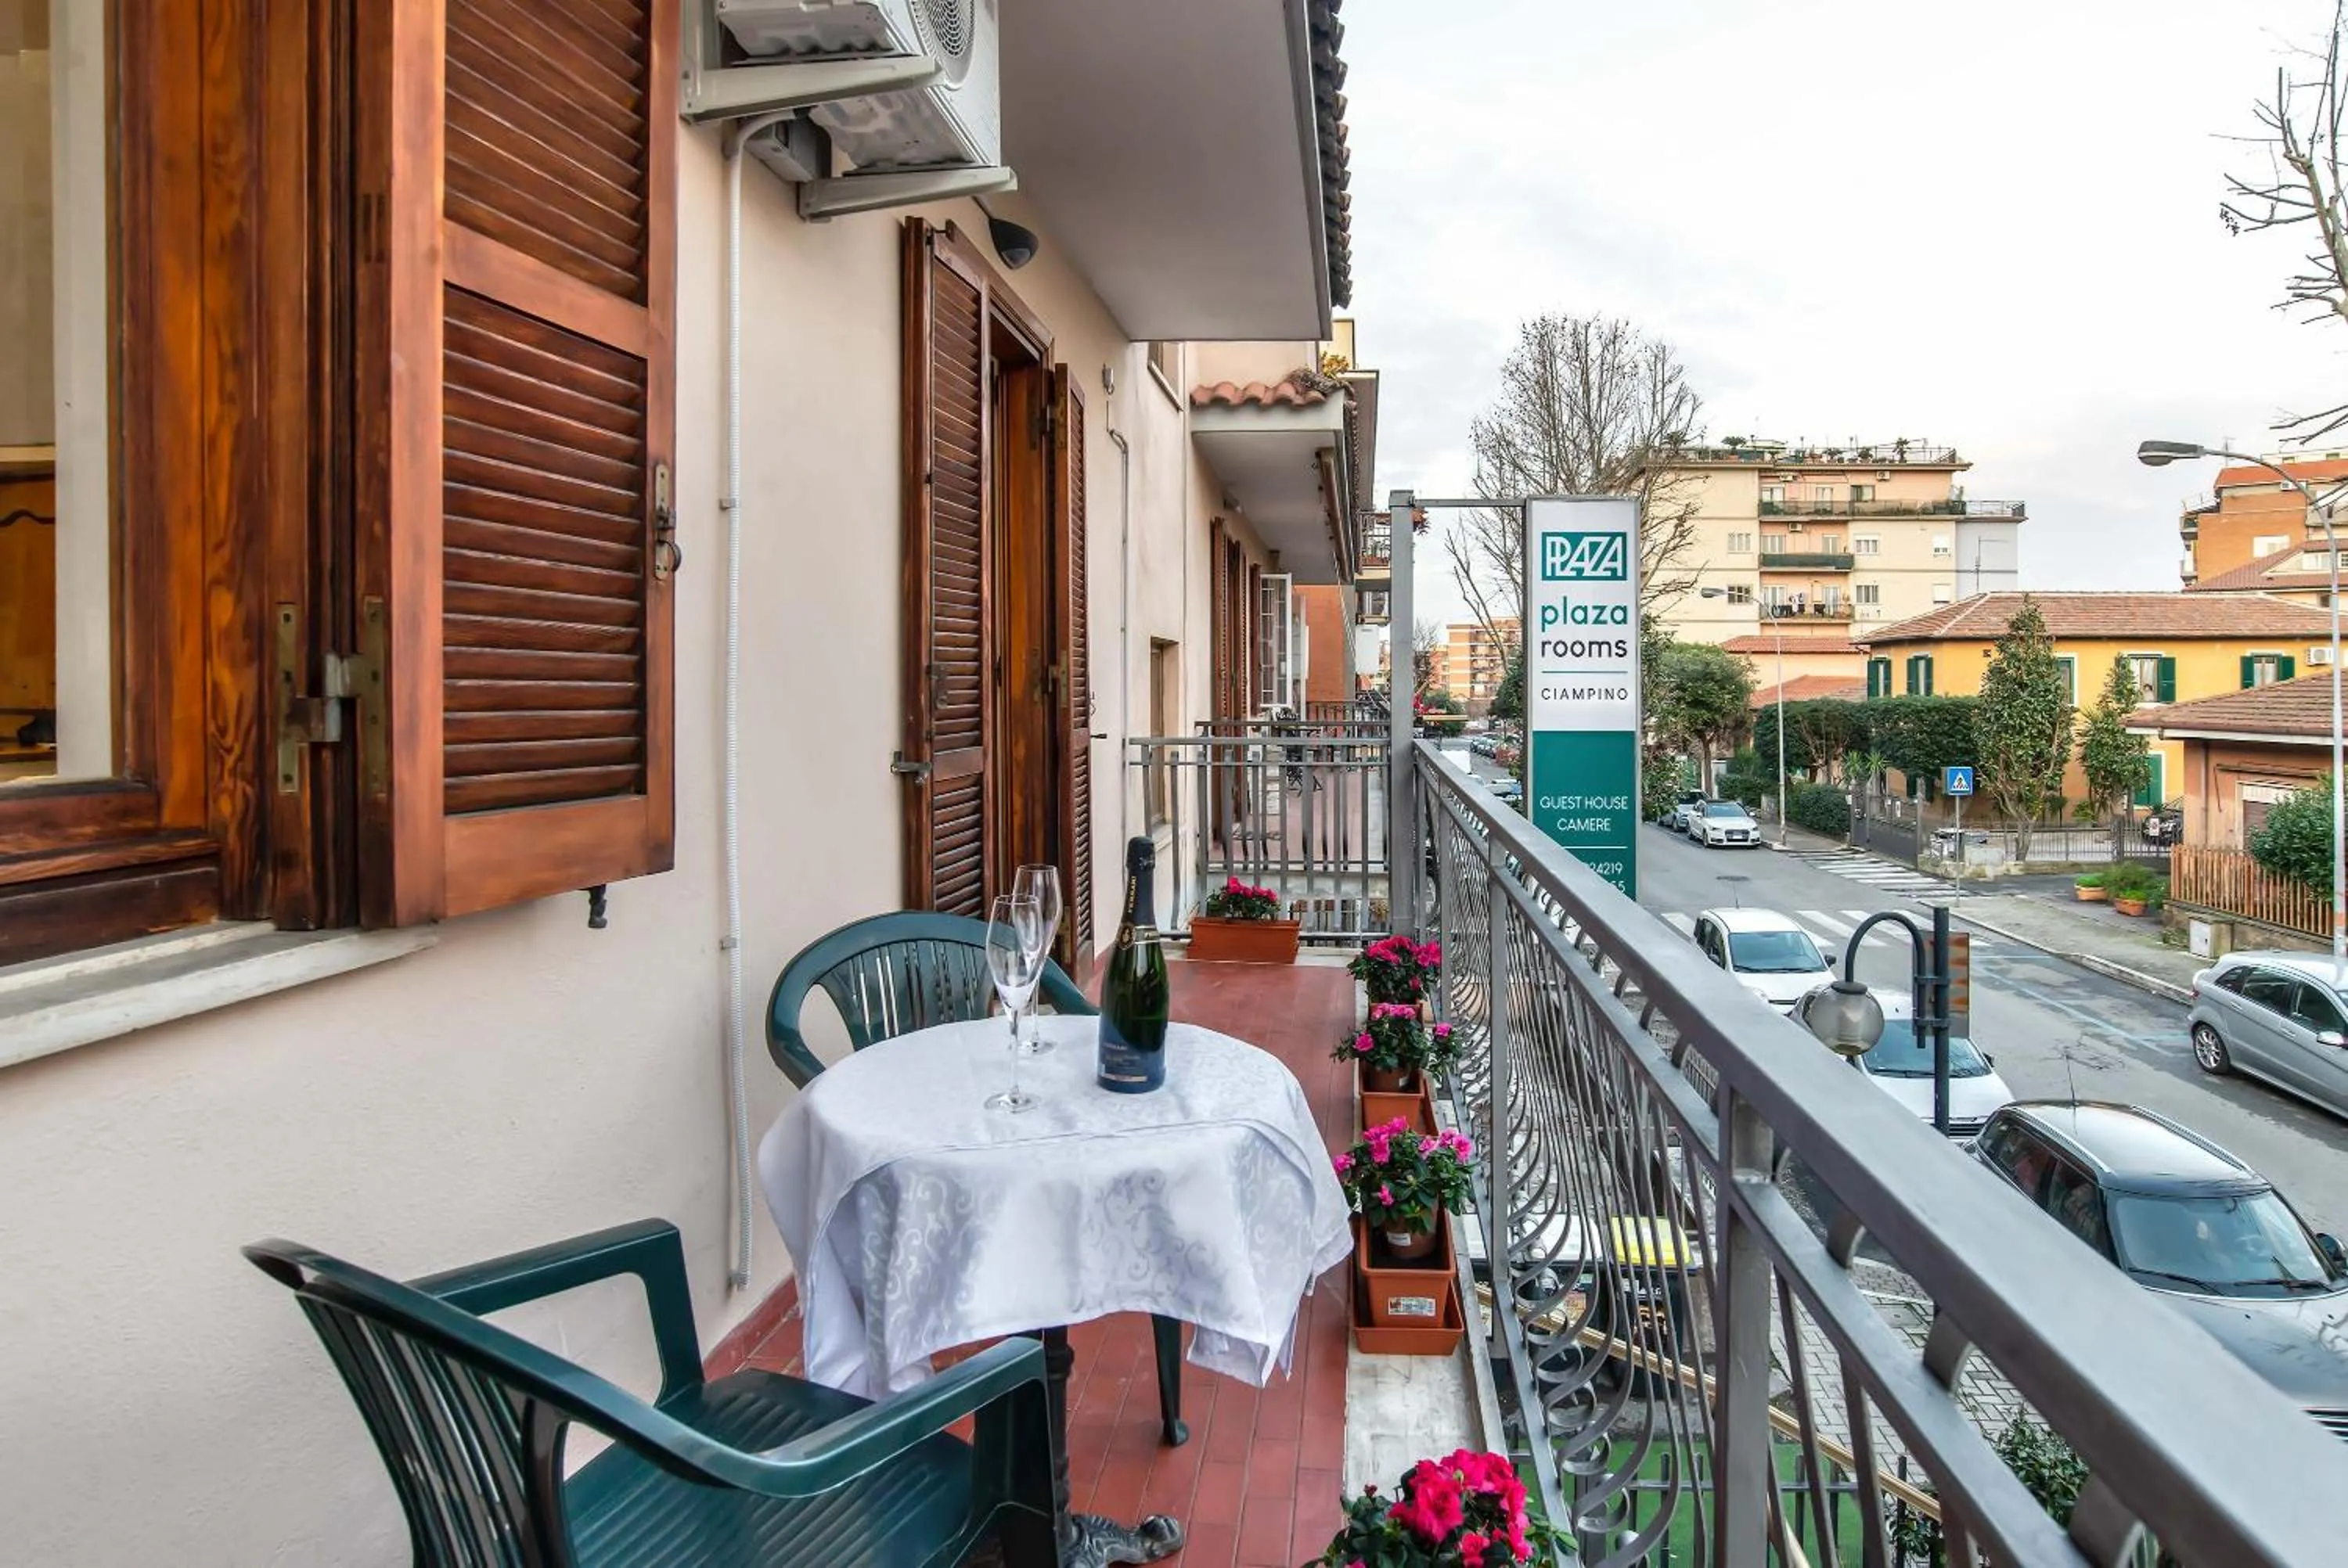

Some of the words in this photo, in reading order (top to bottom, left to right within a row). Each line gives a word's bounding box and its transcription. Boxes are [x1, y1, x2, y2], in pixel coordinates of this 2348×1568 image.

[1546, 536, 1623, 577] PLAZA
[1540, 595, 1628, 632] plaza
[1540, 639, 1628, 658] rooms
[1540, 688, 1629, 700] CIAMPINO
[1540, 796, 1583, 810] GUEST
[1585, 796, 1629, 810] HOUSE
[1557, 818, 1612, 832] CAMERE
